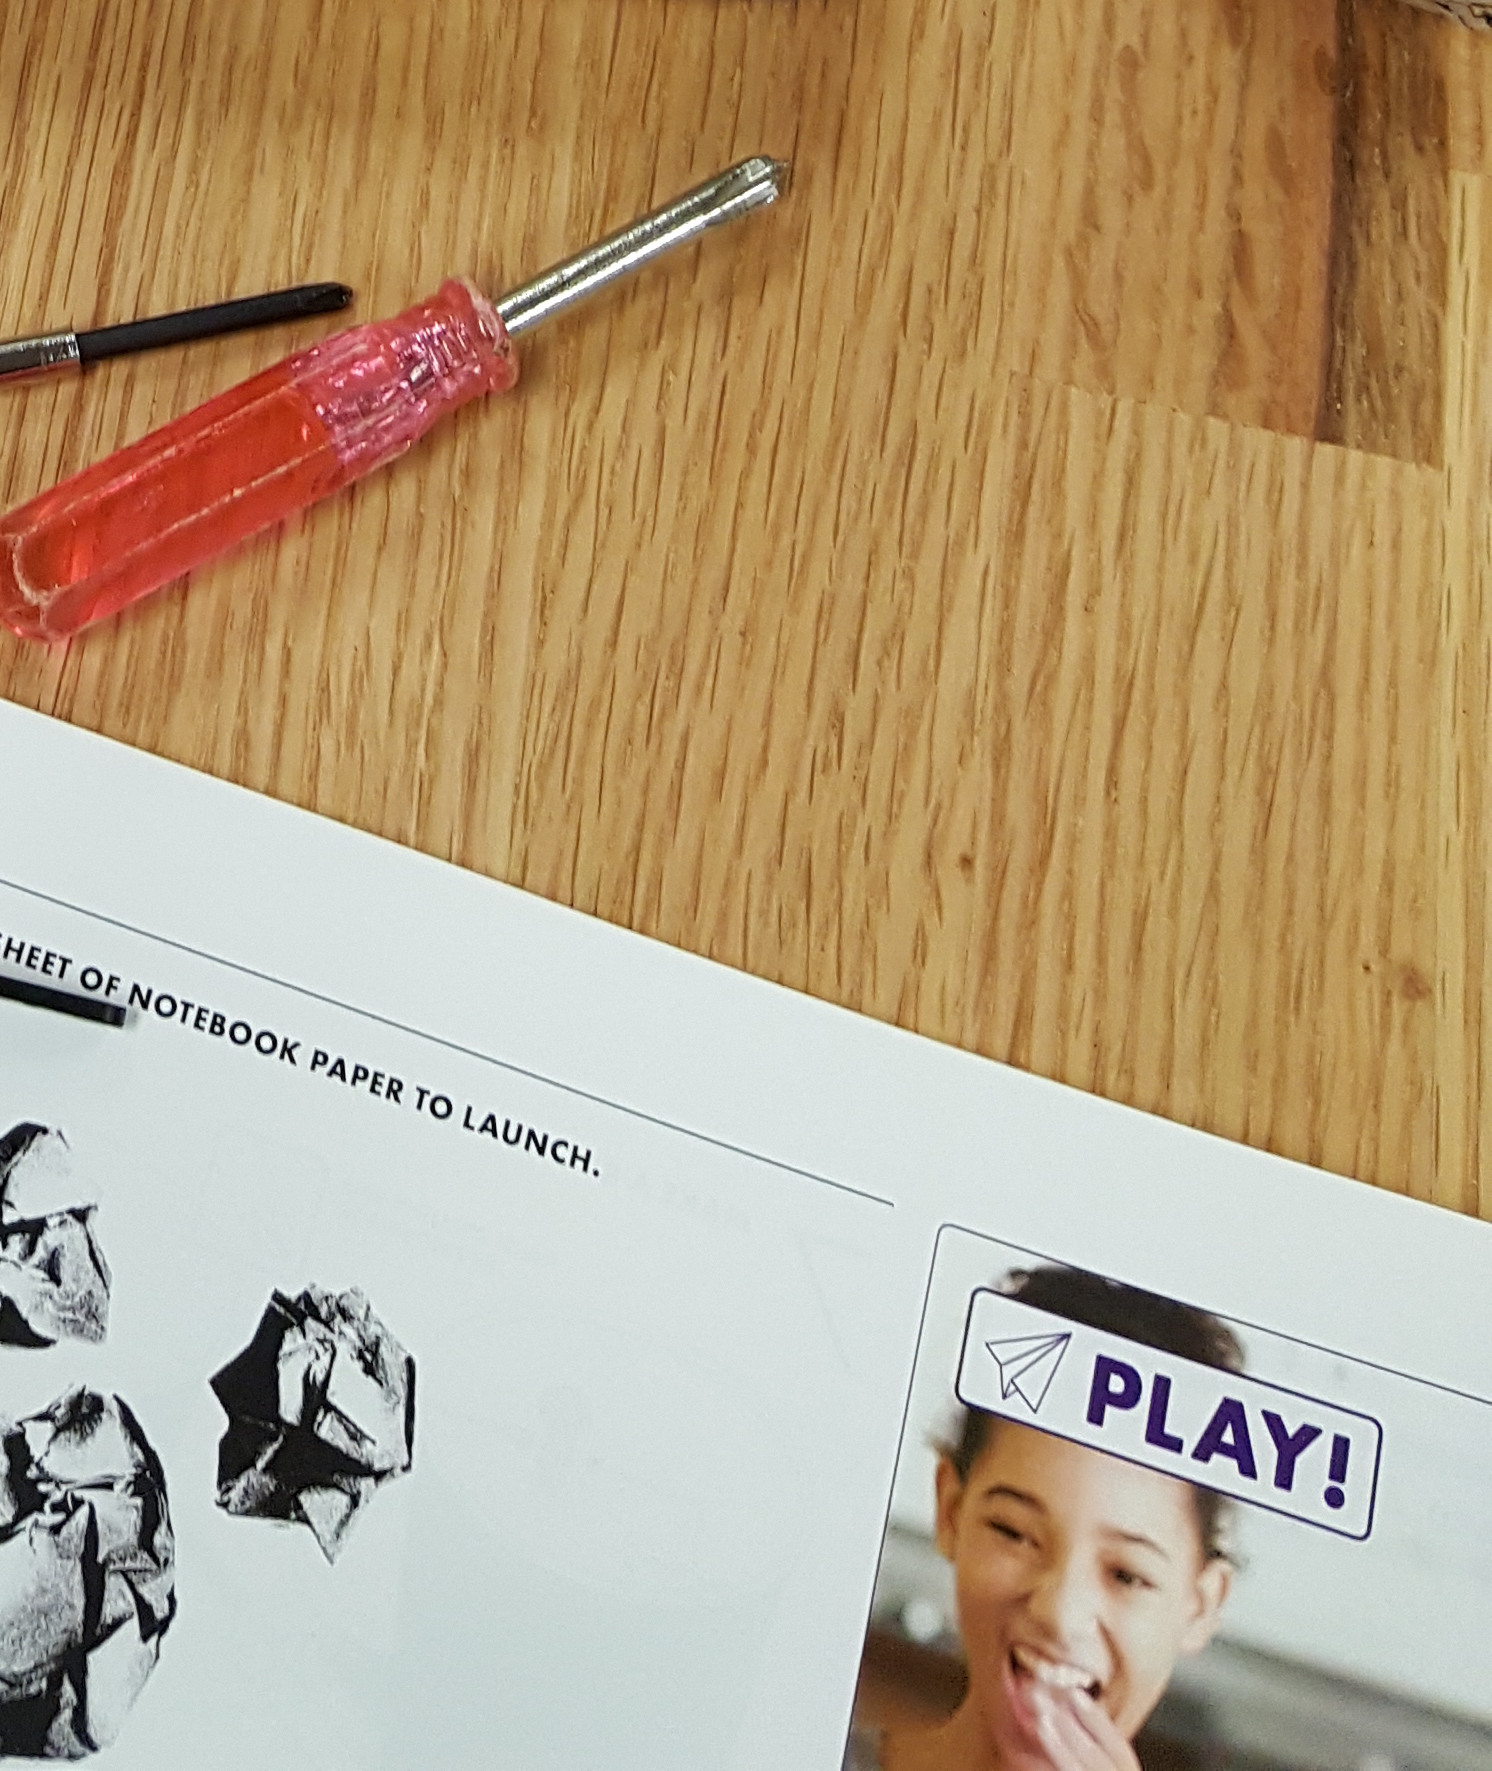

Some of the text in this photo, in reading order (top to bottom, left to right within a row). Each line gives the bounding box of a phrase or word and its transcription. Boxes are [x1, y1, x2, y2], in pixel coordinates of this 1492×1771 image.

[79, 966, 122, 999] OF
[127, 983, 301, 1066] NOTEBOOK
[310, 1049, 404, 1104] PAPER
[416, 1086, 454, 1120] TO
[463, 1105, 601, 1178] LAUNCH.
[1085, 1352, 1352, 1510] PLAY!
